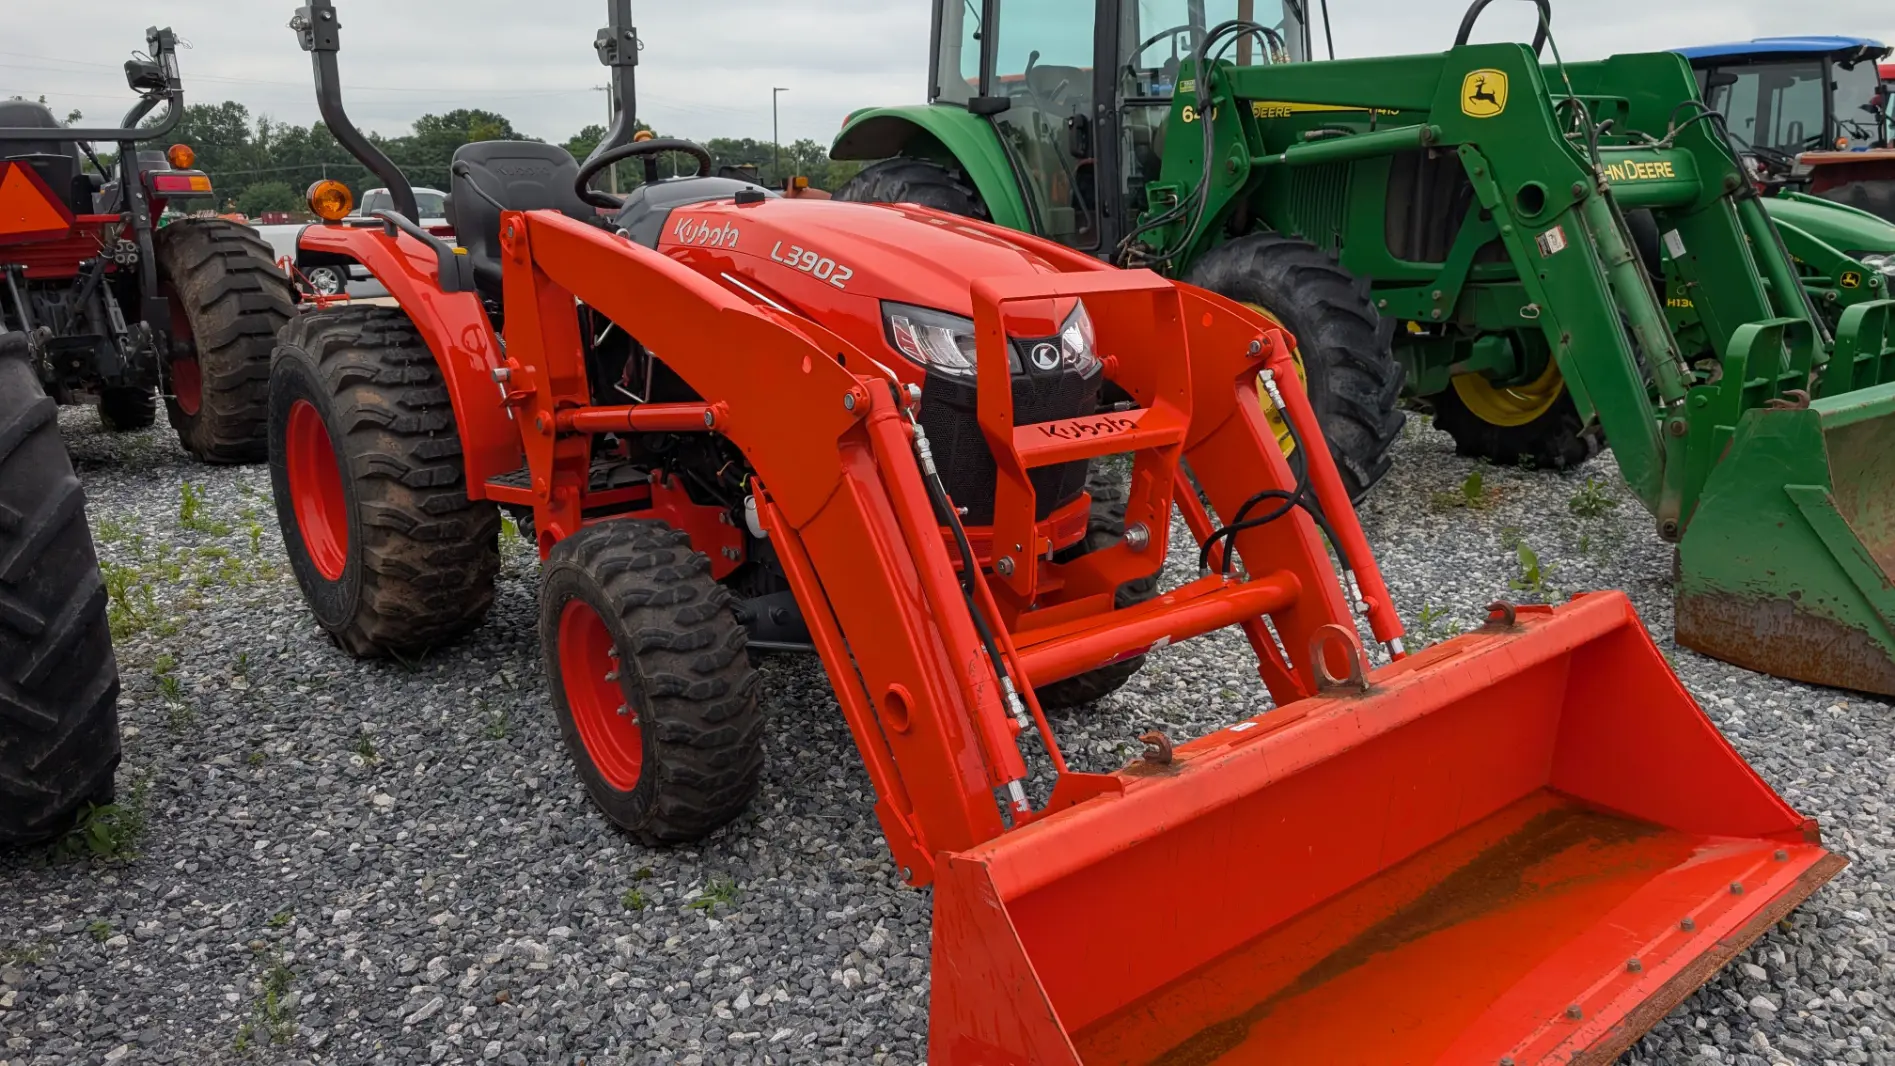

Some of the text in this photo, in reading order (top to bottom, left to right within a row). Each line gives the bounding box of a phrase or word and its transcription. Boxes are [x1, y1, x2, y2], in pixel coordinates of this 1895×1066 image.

[1252, 106, 1292, 118] DEERE
[1623, 160, 1675, 180] DEERE
[673, 217, 740, 247] Kubota
[770, 241, 853, 288] L3902
[1037, 416, 1140, 440] Kubota
